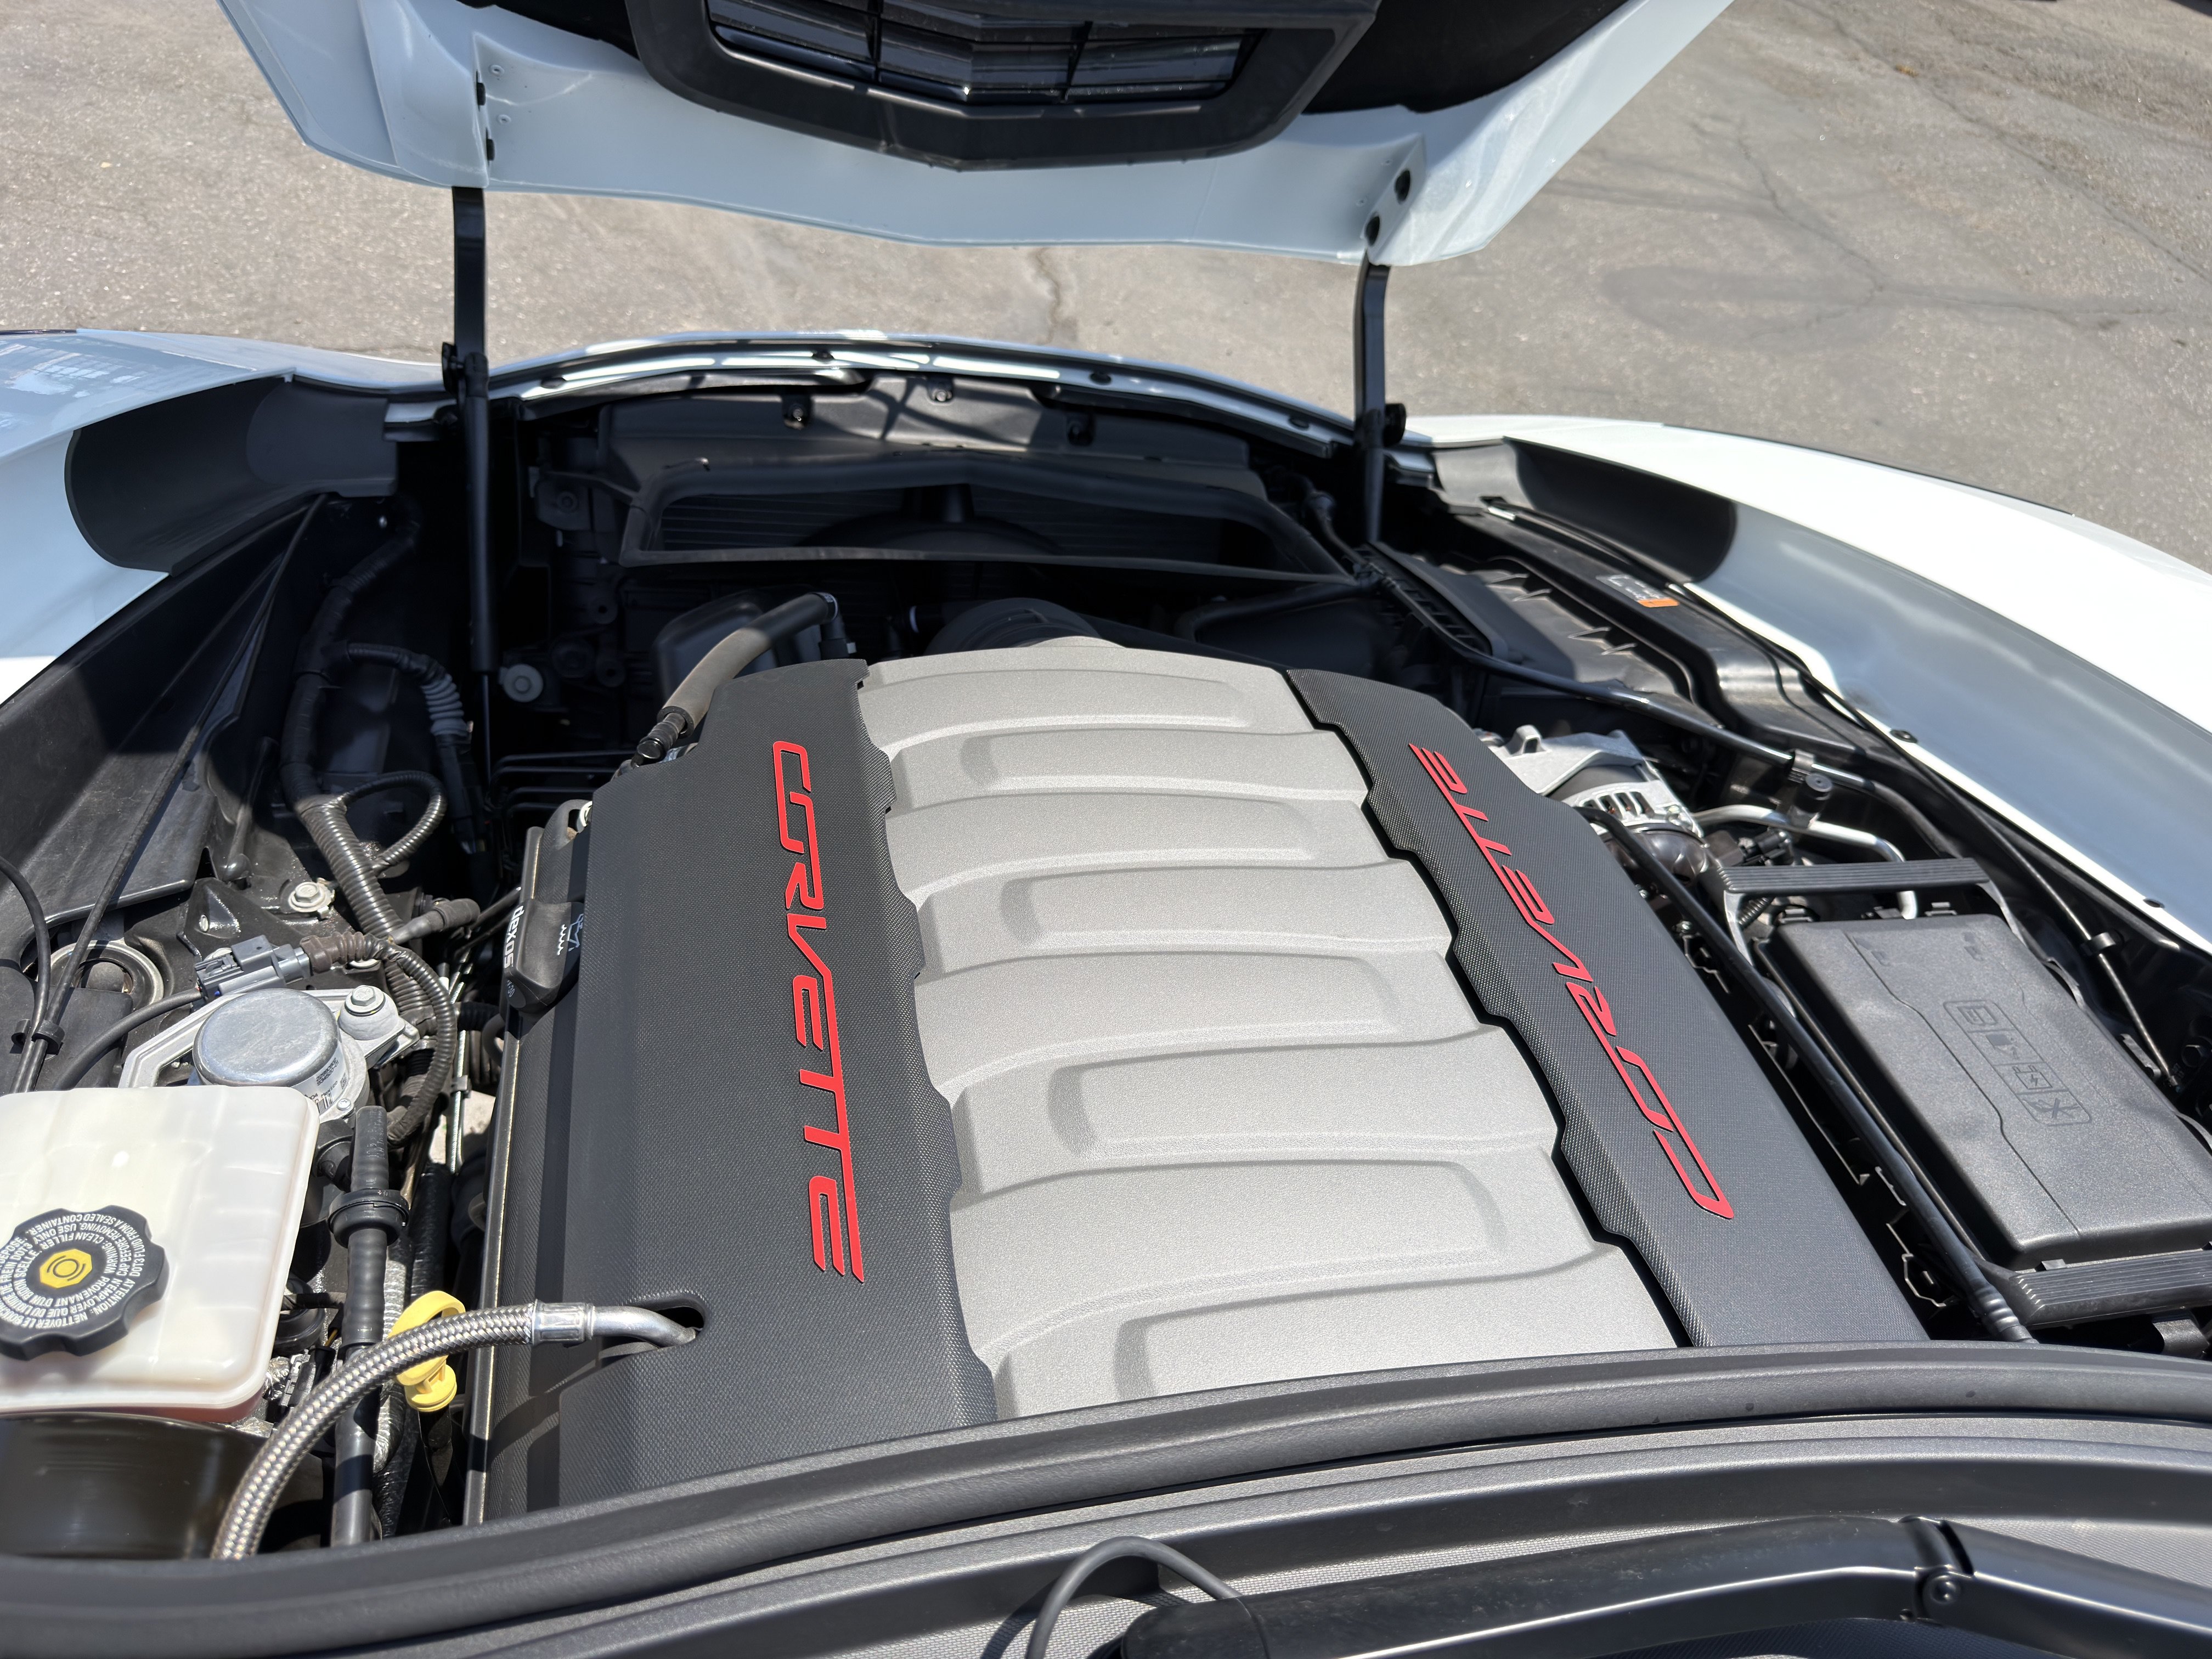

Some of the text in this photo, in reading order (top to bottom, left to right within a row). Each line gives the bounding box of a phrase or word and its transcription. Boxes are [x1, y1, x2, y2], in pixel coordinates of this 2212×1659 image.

[504, 906, 524, 969] dexos
[1409, 743, 1734, 1219] CORVETTE
[772, 741, 865, 1284] CORVETTE
[321, 1081, 337, 1097] Mexico
[26, 1214, 82, 1235] CONTAINER.
[83, 1214, 116, 1225] SEALED
[119, 1223, 140, 1240] FROM
[33, 1223, 132, 1276] CAP BEFORE REMOVING. USE ONLY
[40, 1232, 118, 1274] WARNING: CLEAN FILLER
[131, 1238, 145, 1257] FLUID
[14, 1250, 42, 1278] SCELLE.
[129, 1258, 145, 1277] DOT3
[0, 1243, 123, 1318] N'EMPLOYER QUE DU LIQUIDE DE FREIN DOT3
[14, 1279, 35, 1301] BIDON
[54, 1276, 110, 1307] PROVENANT
[90, 1278, 136, 1315] ATTENTION:
[0, 1298, 24, 1325] BOUCH
[21, 1317, 37, 1328] LE
[36, 1311, 88, 1328] NETTOYER
